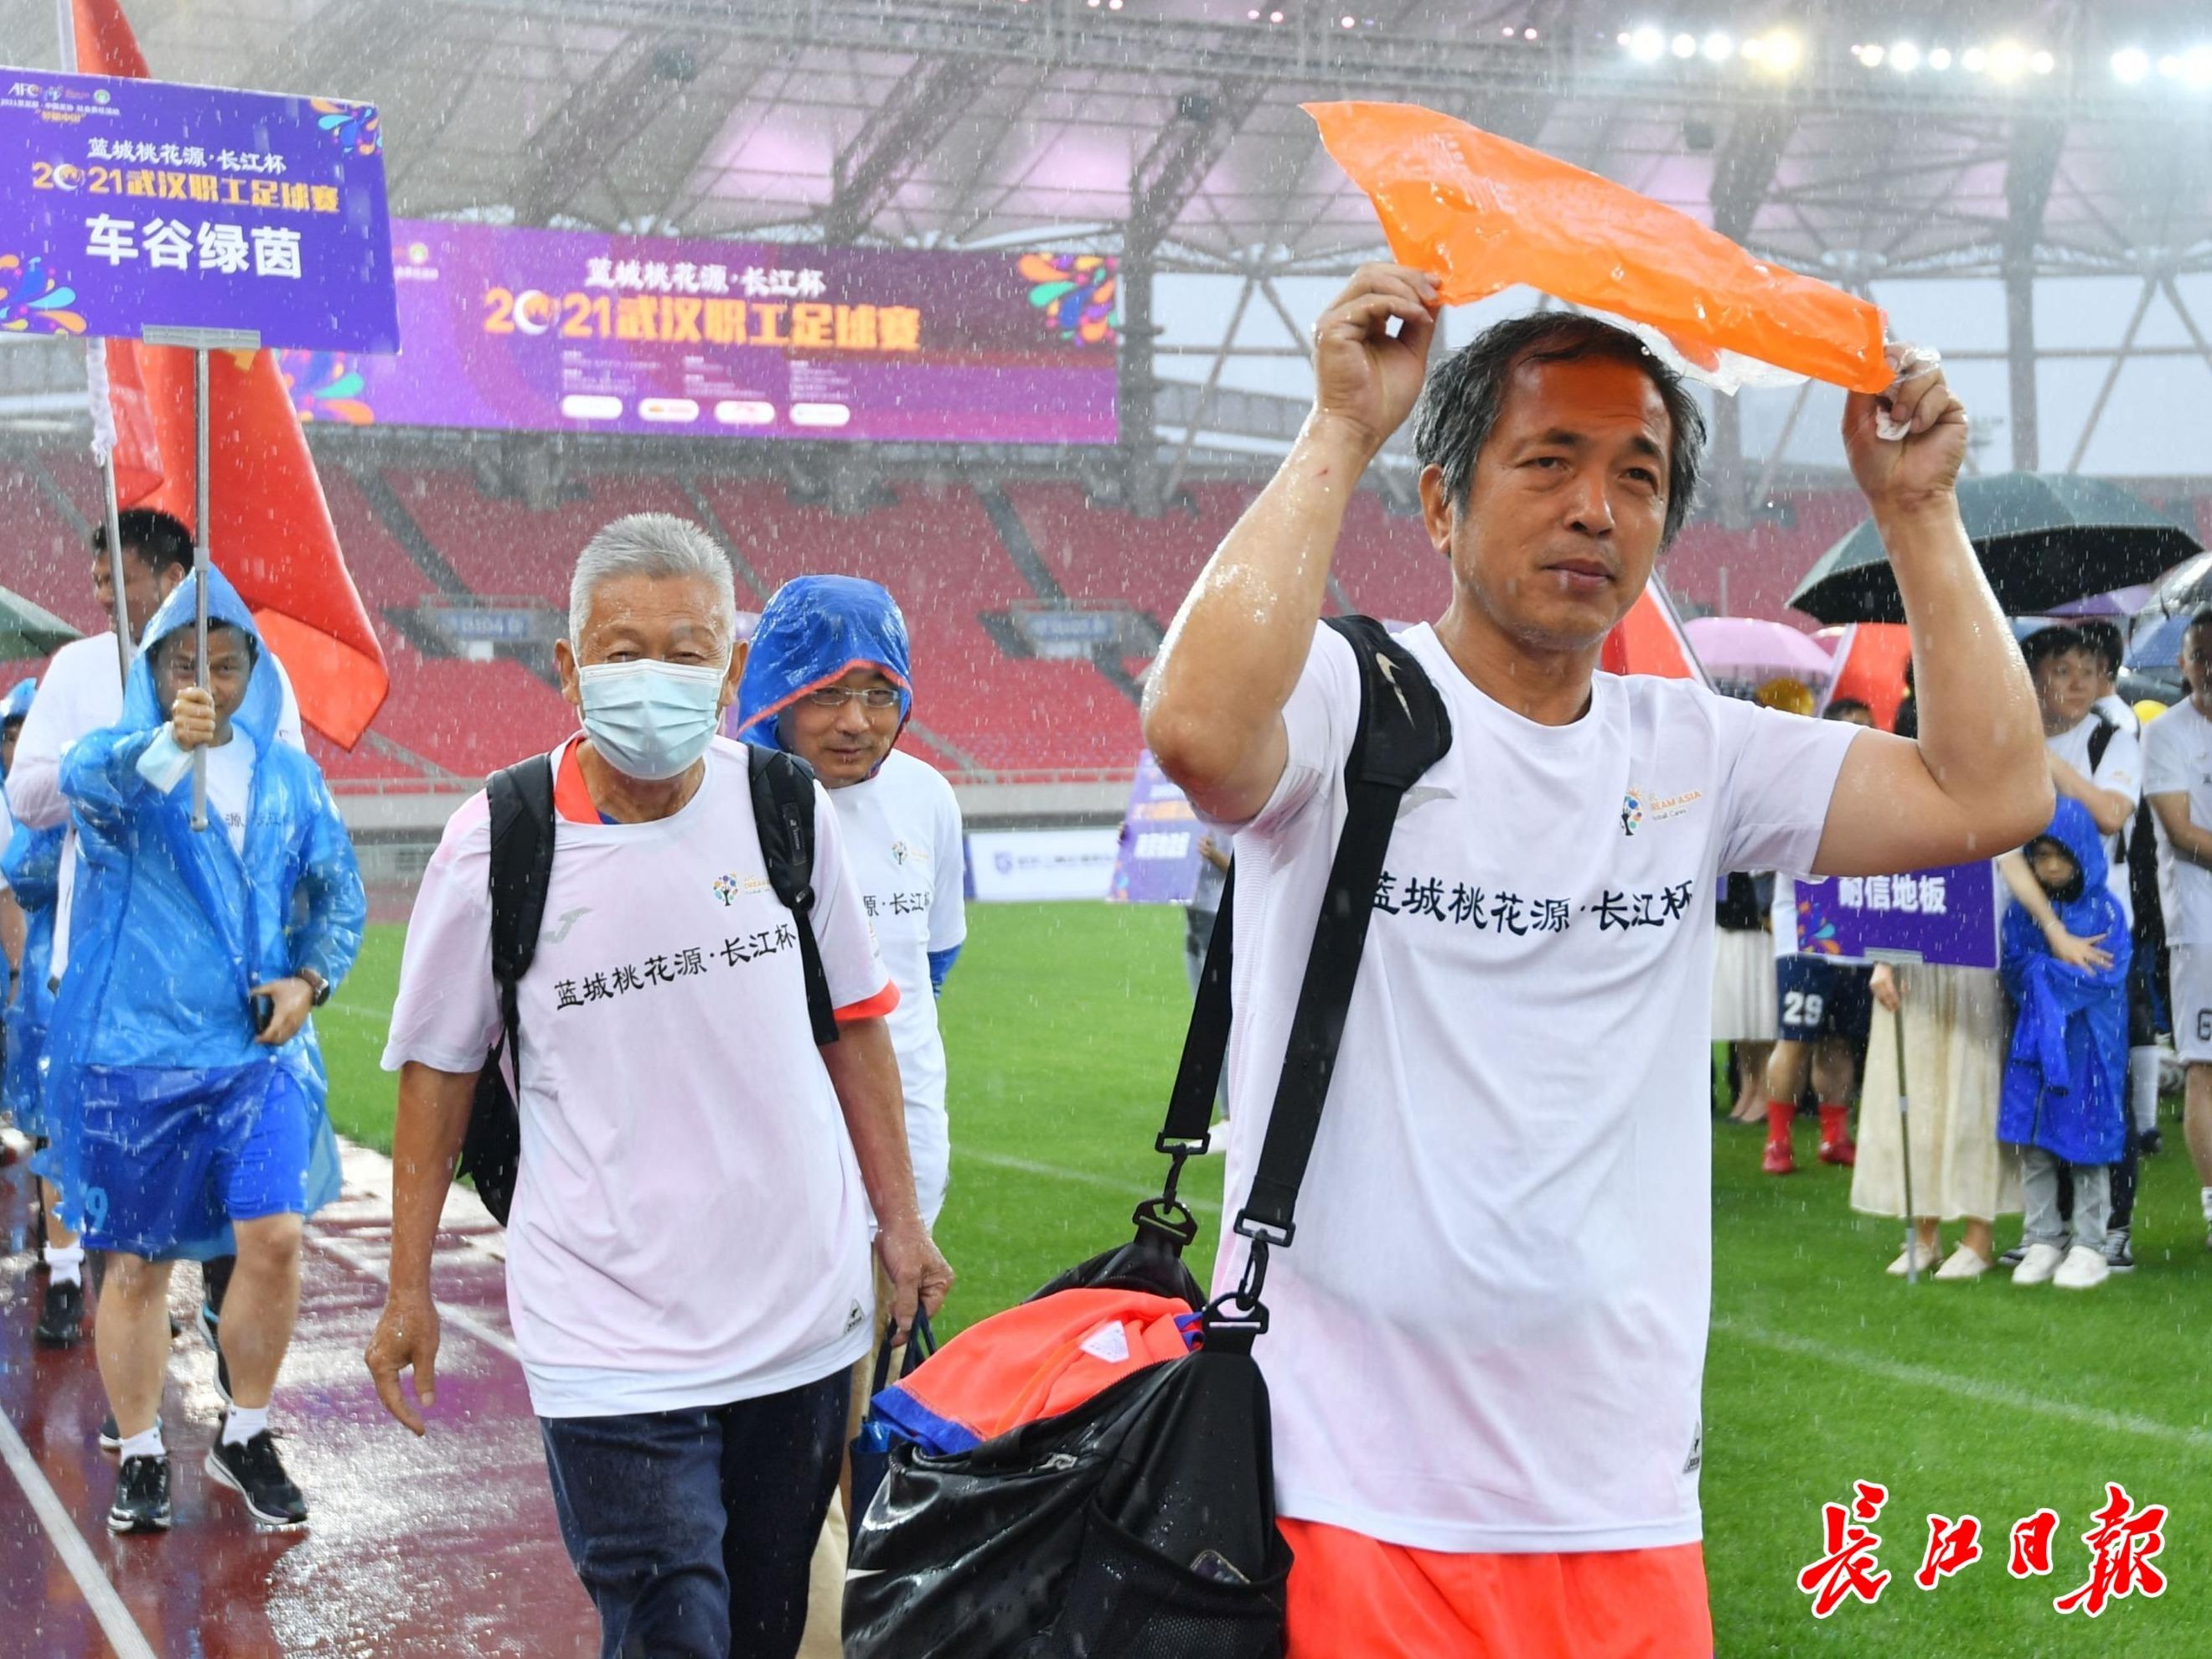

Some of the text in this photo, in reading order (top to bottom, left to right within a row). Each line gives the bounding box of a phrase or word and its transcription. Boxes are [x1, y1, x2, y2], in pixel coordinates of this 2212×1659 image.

[86, 137, 287, 175] 蓝城桃花源·长江杯
[32, 162, 340, 214] 2021武汉职工足球赛
[85, 213, 302, 279] 车谷绿茵
[586, 256, 827, 297] 蓝城桃花源·长江杯
[483, 287, 921, 353] 2021武汉职工足球赛
[1371, 870, 1694, 935] 蓝城桃花源·长江杯
[555, 923, 798, 1010] 蓝城桃花源·长江杯
[1782, 990, 1824, 1026] 29
